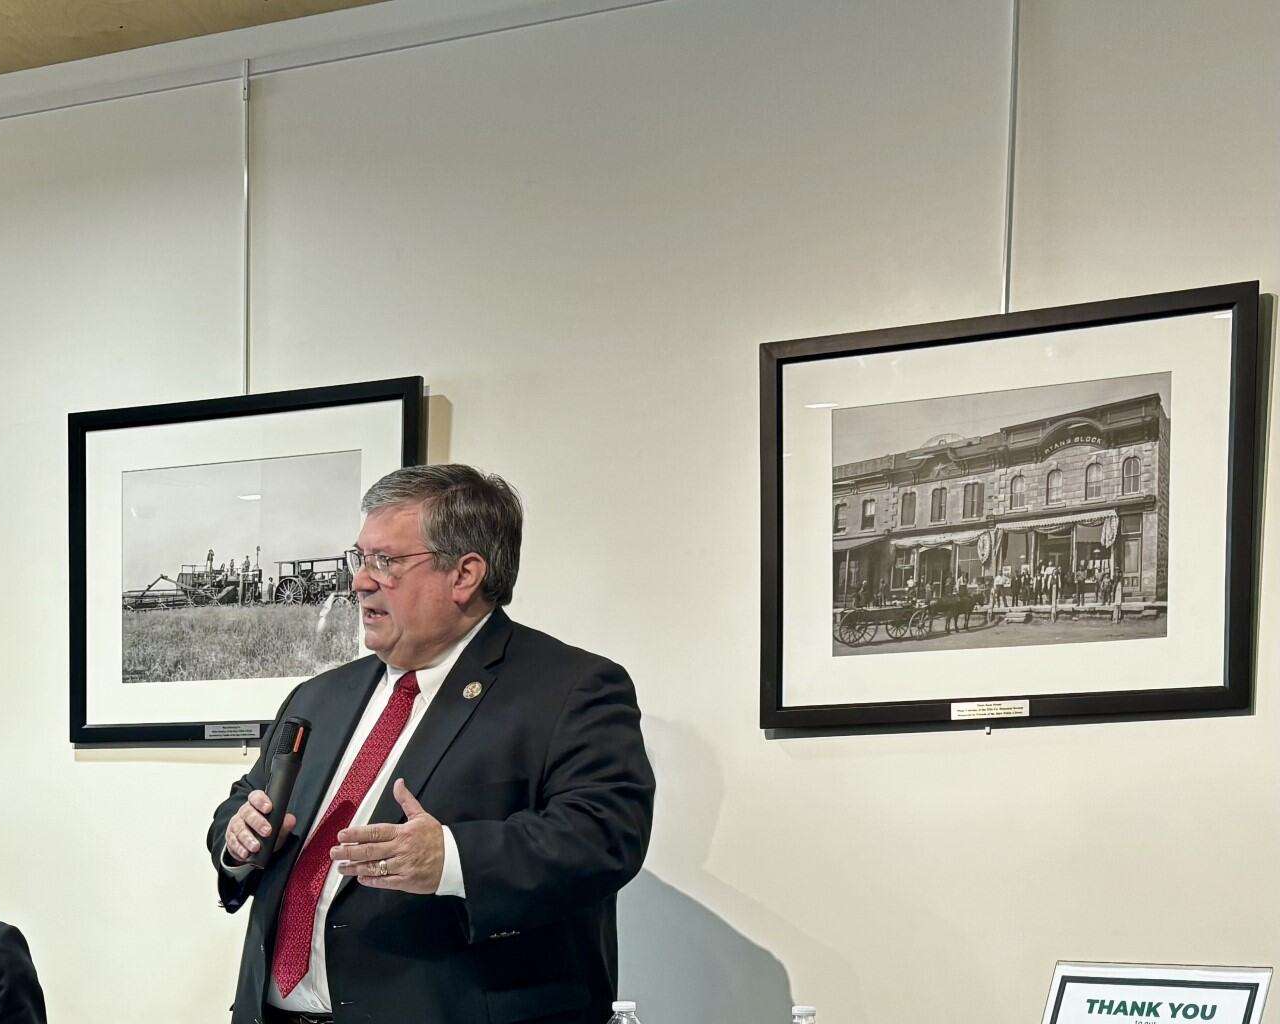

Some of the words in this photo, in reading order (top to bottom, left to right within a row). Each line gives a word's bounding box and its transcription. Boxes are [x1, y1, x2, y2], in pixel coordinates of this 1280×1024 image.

[1074, 436, 1102, 444] BLOCK
[1086, 998, 1163, 1018] THANK
[1168, 1002, 1218, 1021] YOU
